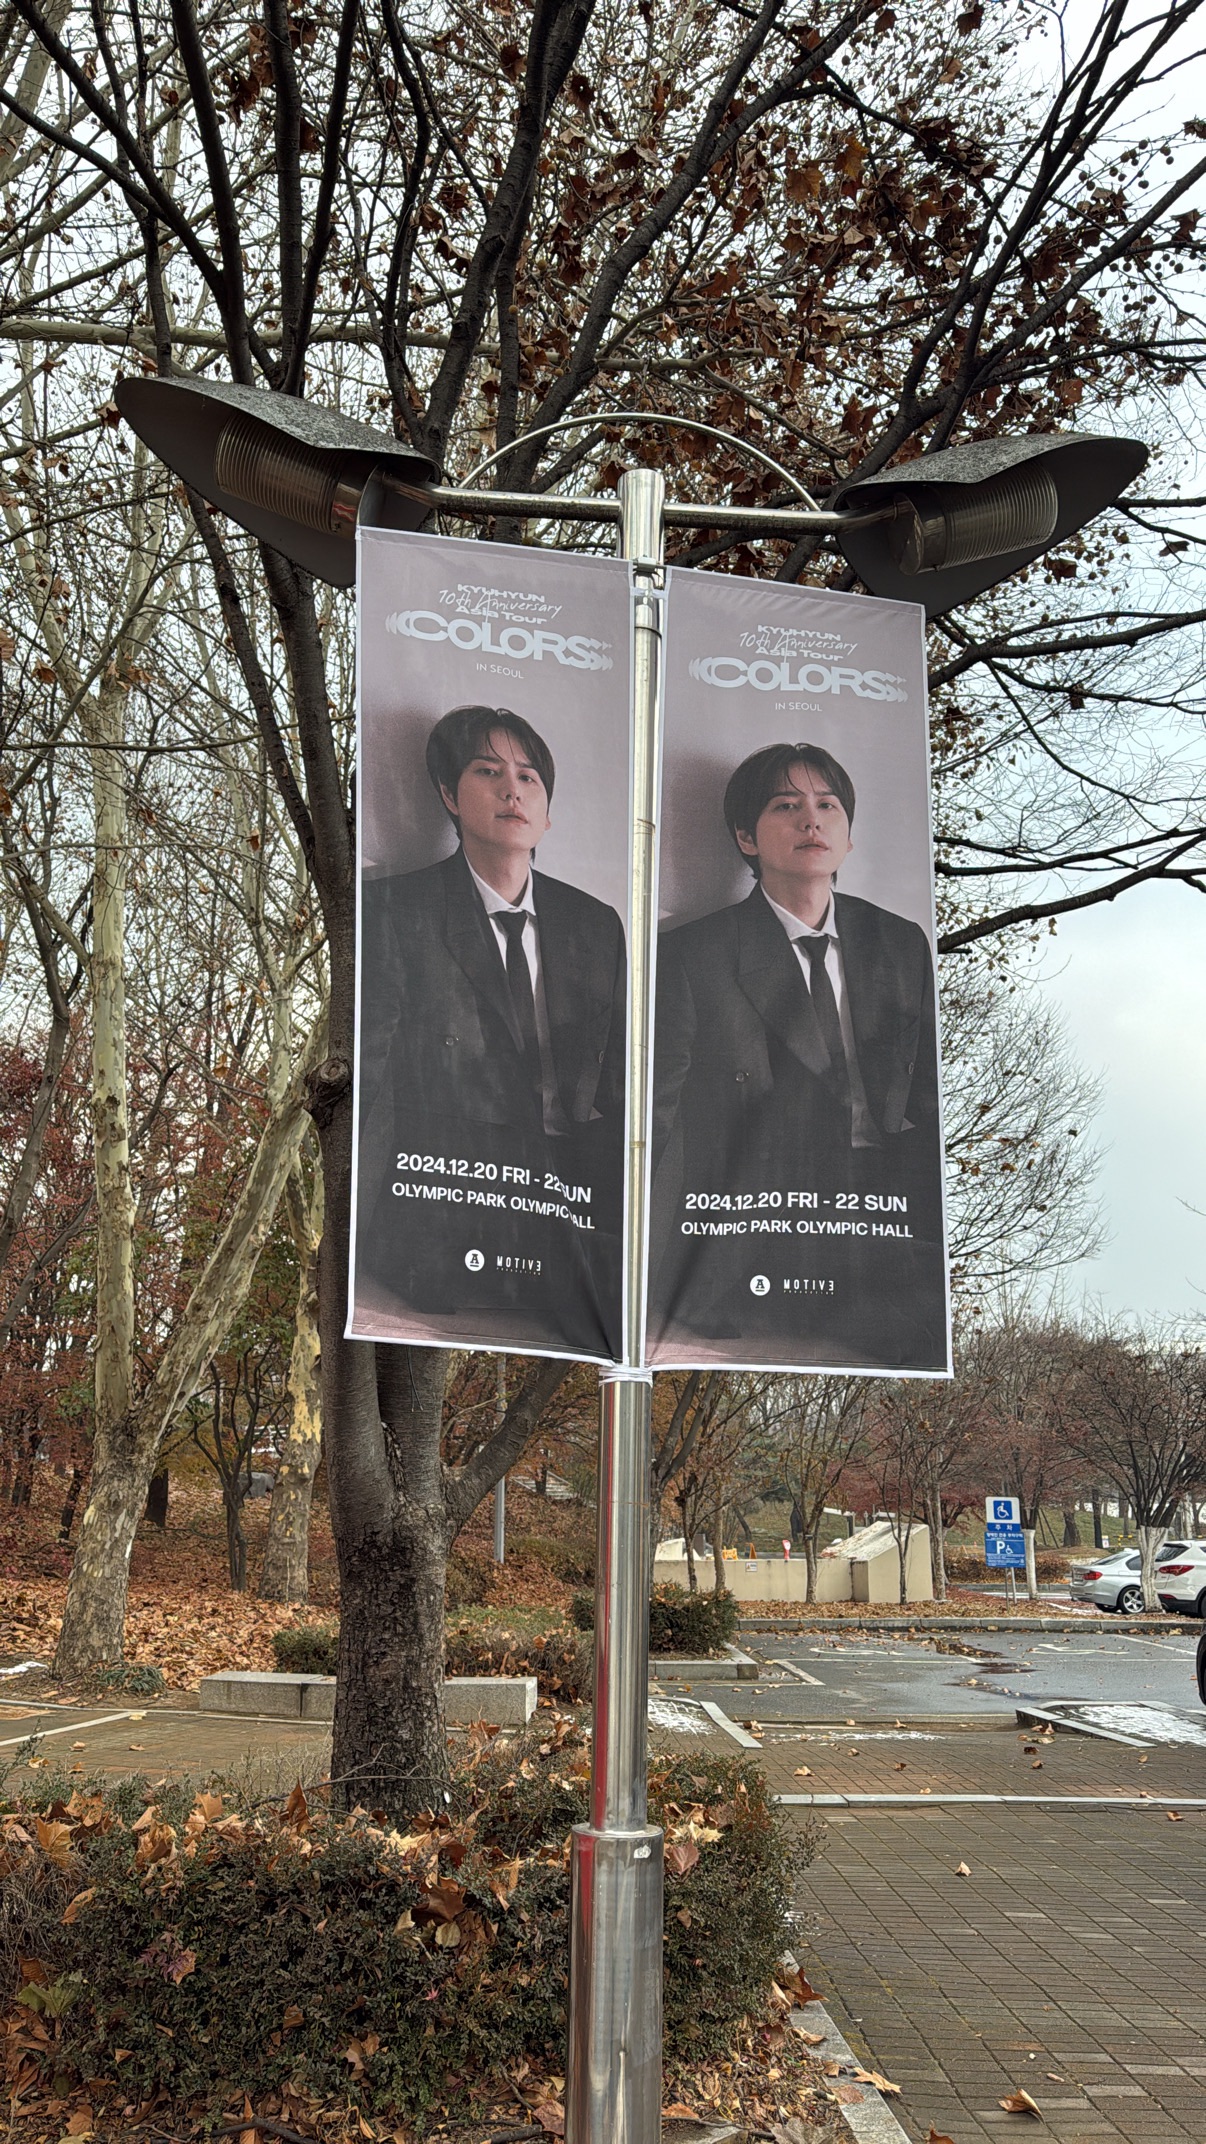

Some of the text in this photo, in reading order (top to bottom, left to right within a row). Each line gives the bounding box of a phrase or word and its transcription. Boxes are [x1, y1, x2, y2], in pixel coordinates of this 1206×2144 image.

[457, 583, 545, 602] KYUHYUN
[438, 589, 563, 623] 10th Anniversary
[455, 606, 547, 625] Asia Tour
[386, 610, 613, 671] COLORS
[757, 624, 841, 641] KYUHYUN
[739, 631, 858, 663] 10th Anniversary
[755, 647, 843, 661] Asia Tour
[476, 663, 524, 679] IN SEOUL
[689, 657, 908, 702] COLORS
[775, 702, 822, 712] IN SEOUL
[396, 1152, 498, 1181] 2024.12.20
[502, 1165, 530, 1185] FRI
[392, 1182, 595, 1229] OLYMPIC PARK OLYMPIC ALL
[685, 1191, 782, 1211] 2024.12.20
[787, 1192, 818, 1208] FRI
[835, 1193, 859, 1210] 22
[864, 1194, 908, 1213] SUN
[681, 1220, 913, 1238] OLYMPIC PARK OLYMPIC HALL
[996, 1541, 1005, 1554] P
